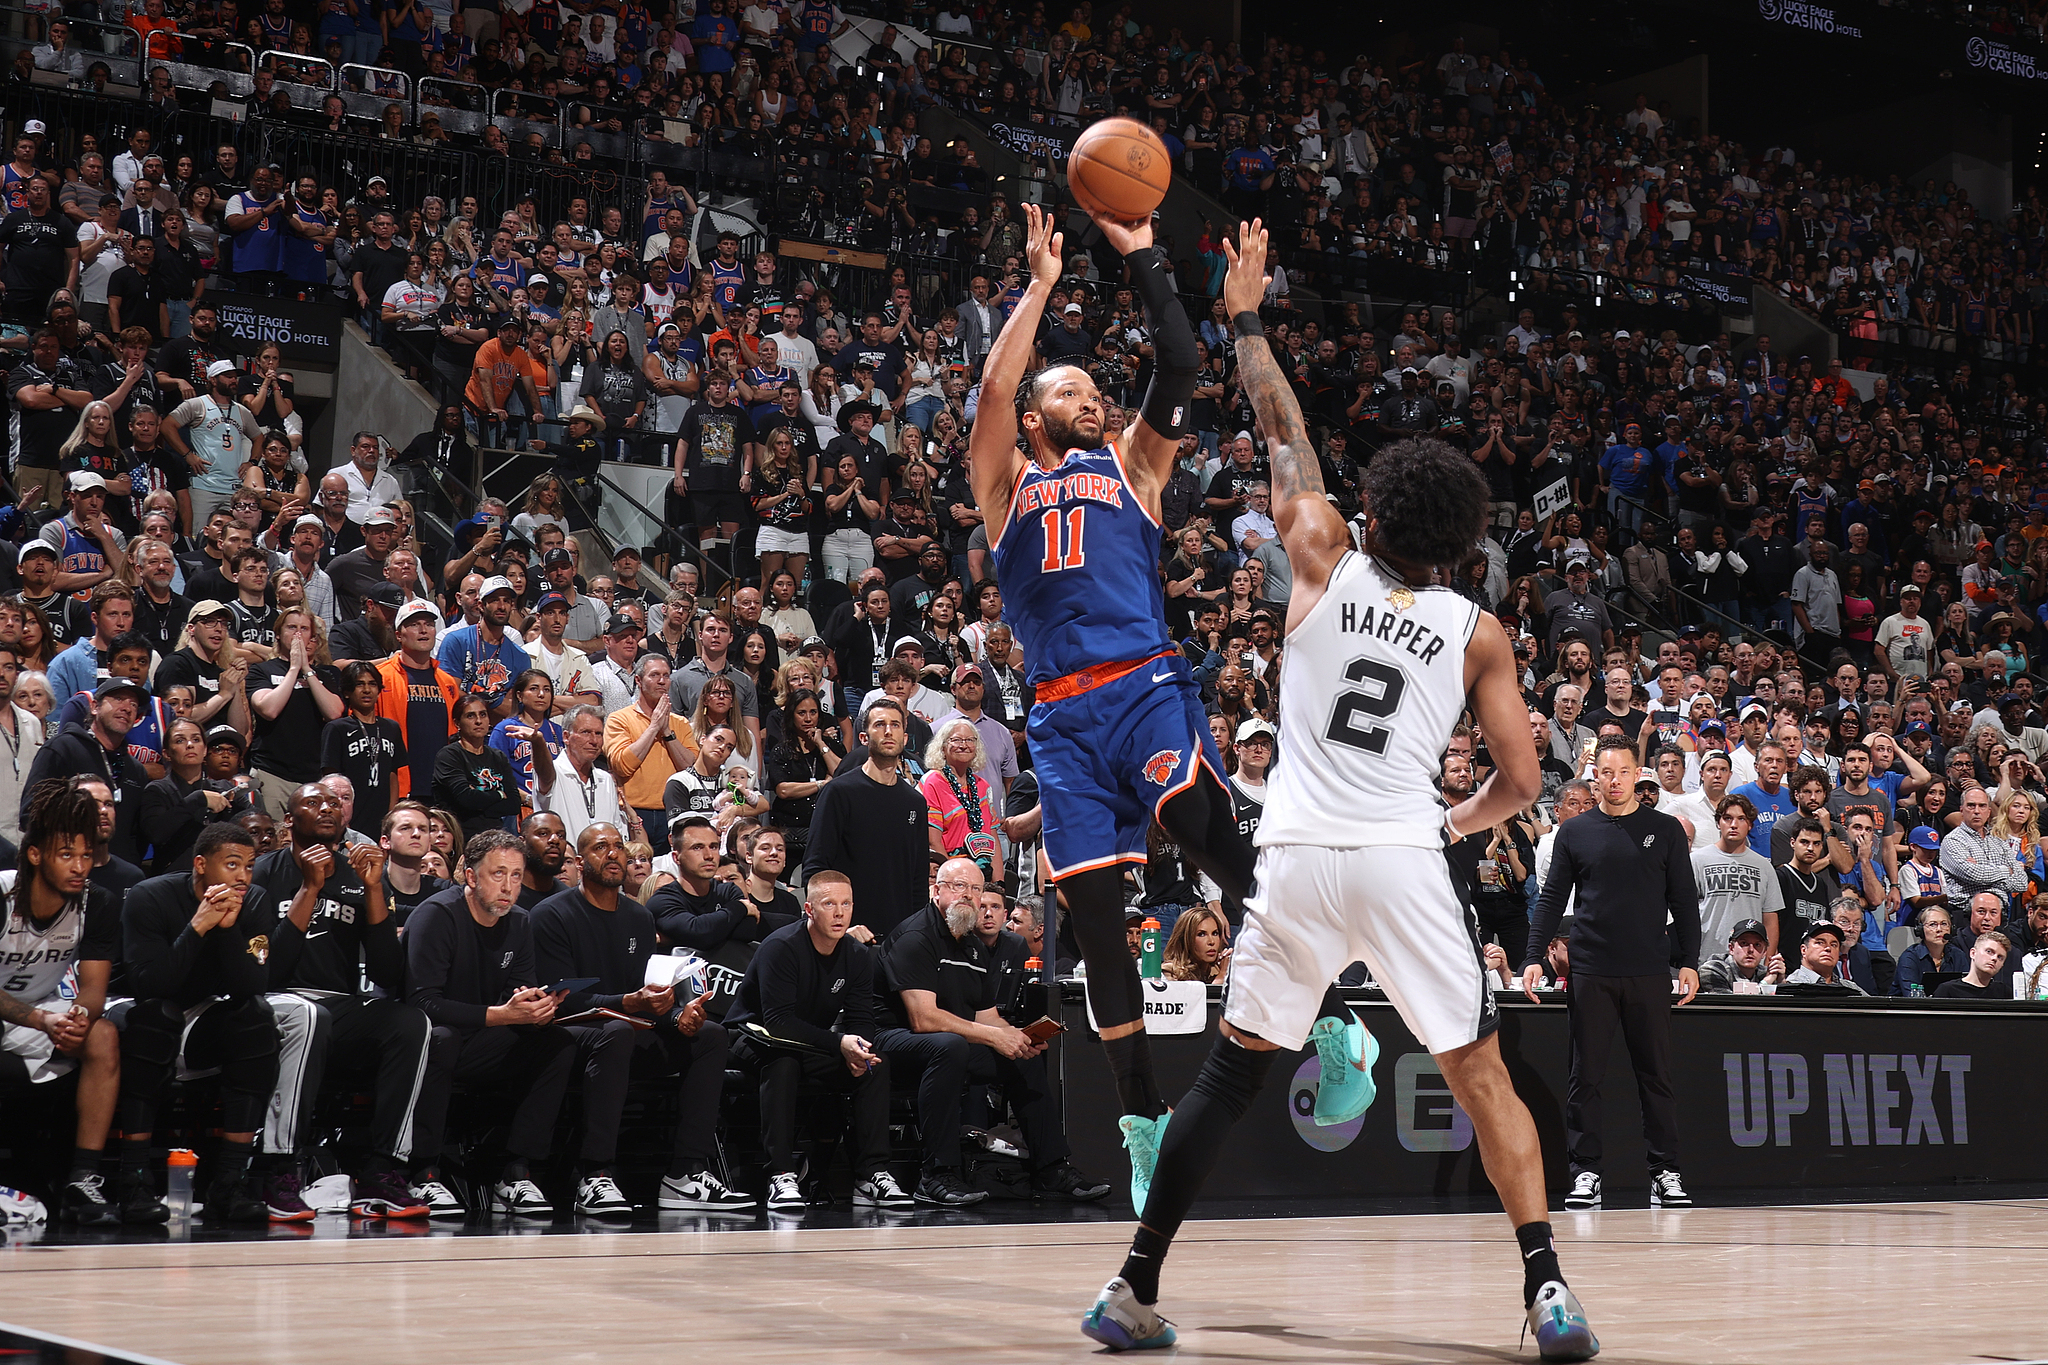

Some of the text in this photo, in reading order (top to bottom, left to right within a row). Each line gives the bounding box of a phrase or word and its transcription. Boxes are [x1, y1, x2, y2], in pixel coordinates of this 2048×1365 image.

[1783, 0, 1835, 20] LUCKY EAGLE
[810, 19, 827, 33] 10
[1783, 12, 1863, 39] CASINO HOTEL
[1988, 46, 2036, 66] LUCKY EAGLE
[1988, 57, 2036, 80] CASINO
[1012, 131, 1038, 145] LUCKY
[258, 216, 270, 231] 3
[725, 286, 735, 302] 8
[1730, 296, 1749, 305] HOTEL
[222, 304, 253, 314] KICKAPOO
[222, 311, 292, 329] LUCKY EAGLE
[294, 333, 330, 347] HOTEL
[603, 376, 635, 393] Finals
[1242, 409, 1250, 422] 5
[1016, 472, 1123, 523] NEW YORK
[1041, 505, 1086, 575] 11
[87, 552, 104, 570] YO
[1341, 602, 1445, 666] HARPER
[1320, 653, 1410, 762] 2
[514, 742, 533, 761] NE
[1146, 752, 1179, 774] KNICKS
[1757, 811, 1775, 824] NEW
[1175, 861, 1185, 882] 1
[1704, 865, 1761, 878] BEST OF THE
[1706, 873, 1762, 893] WEST
[278, 899, 356, 925] SURS
[1143, 938, 1155, 953] G
[4, 974, 34, 992] 5
[1143, 1002, 1184, 1015] RADE
[1723, 1053, 1972, 1148] UP NEXT
